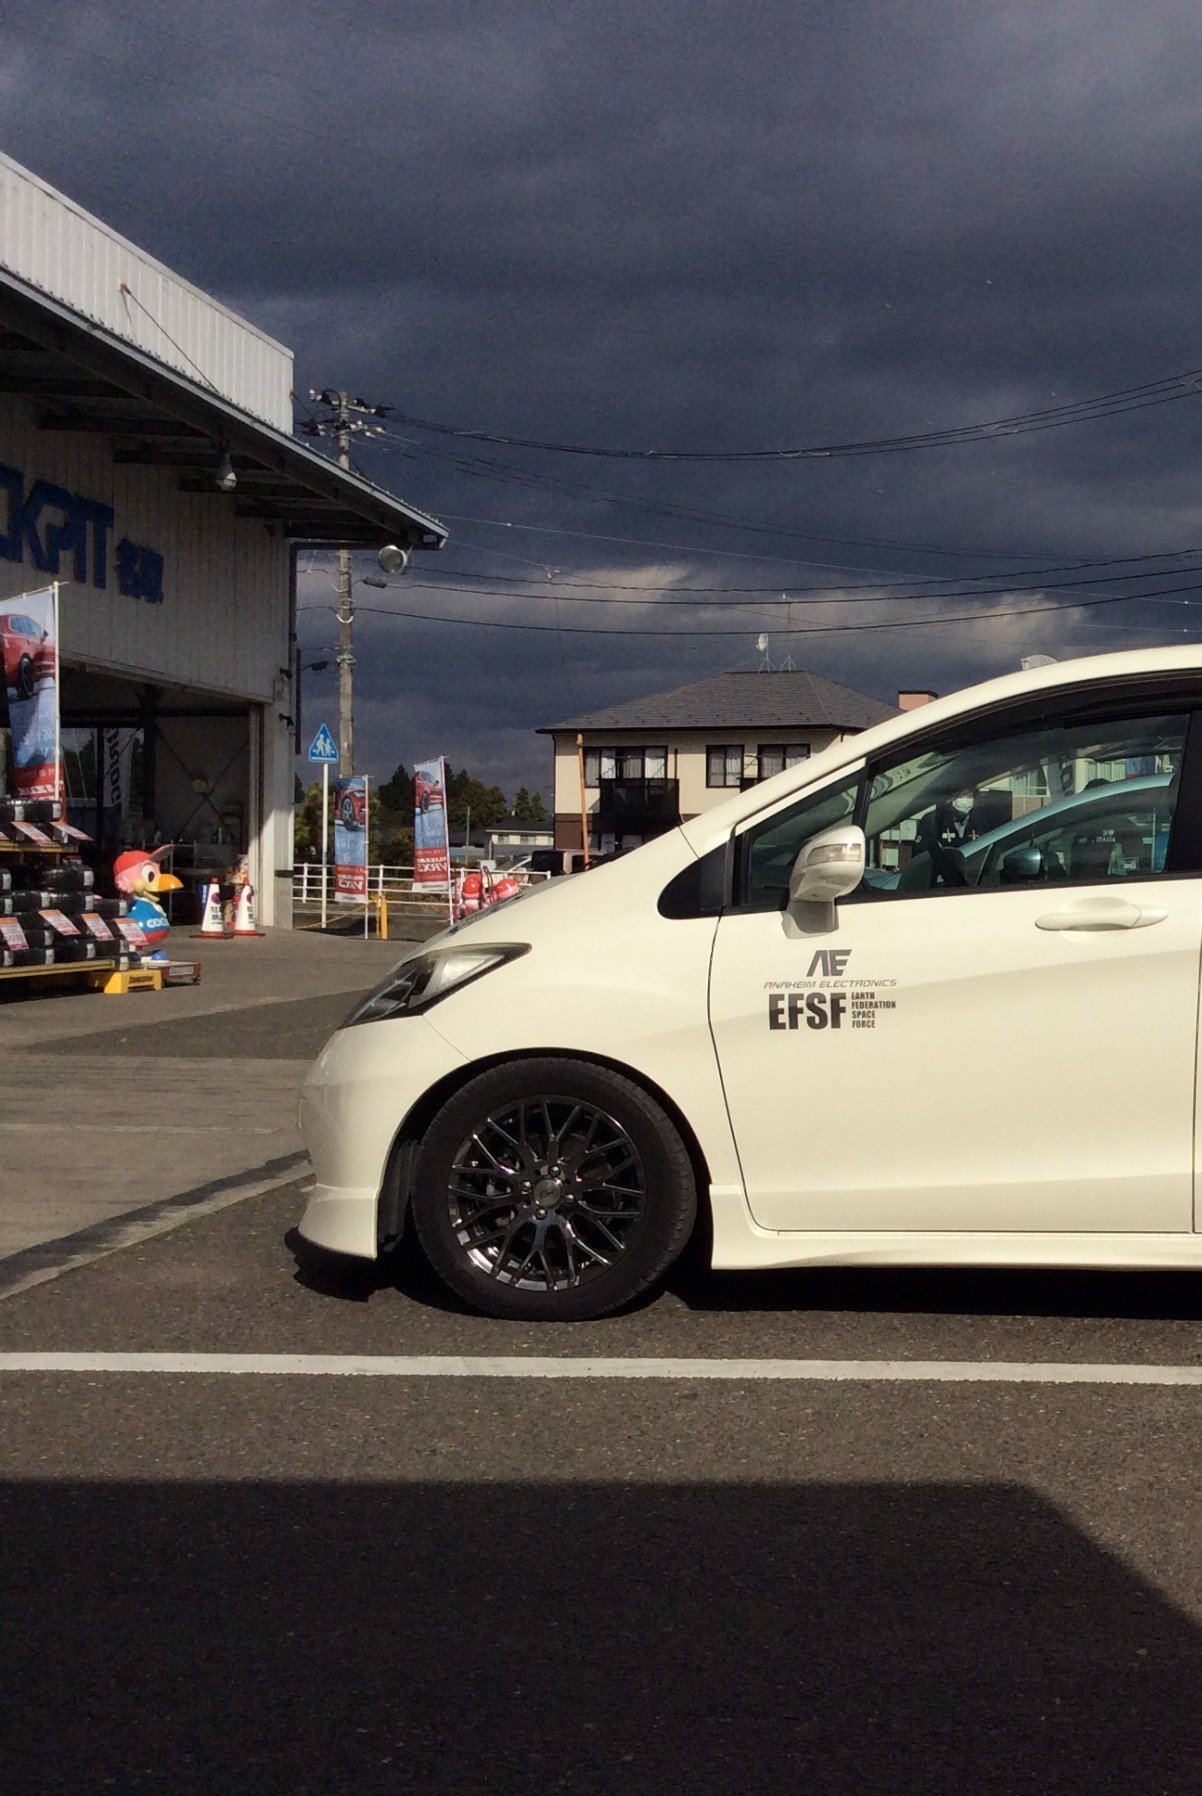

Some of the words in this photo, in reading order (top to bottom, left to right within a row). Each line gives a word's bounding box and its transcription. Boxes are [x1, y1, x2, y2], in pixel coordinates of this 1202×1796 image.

[764, 981, 816, 989] ANAHEIM
[819, 979, 897, 988] ELECTRONICS
[851, 992, 875, 1000] EARTH
[851, 1001, 896, 1009] FEDERATION
[769, 992, 846, 1030] EFSF
[852, 1010, 876, 1019] SPACE
[852, 1020, 876, 1028] FORCE
